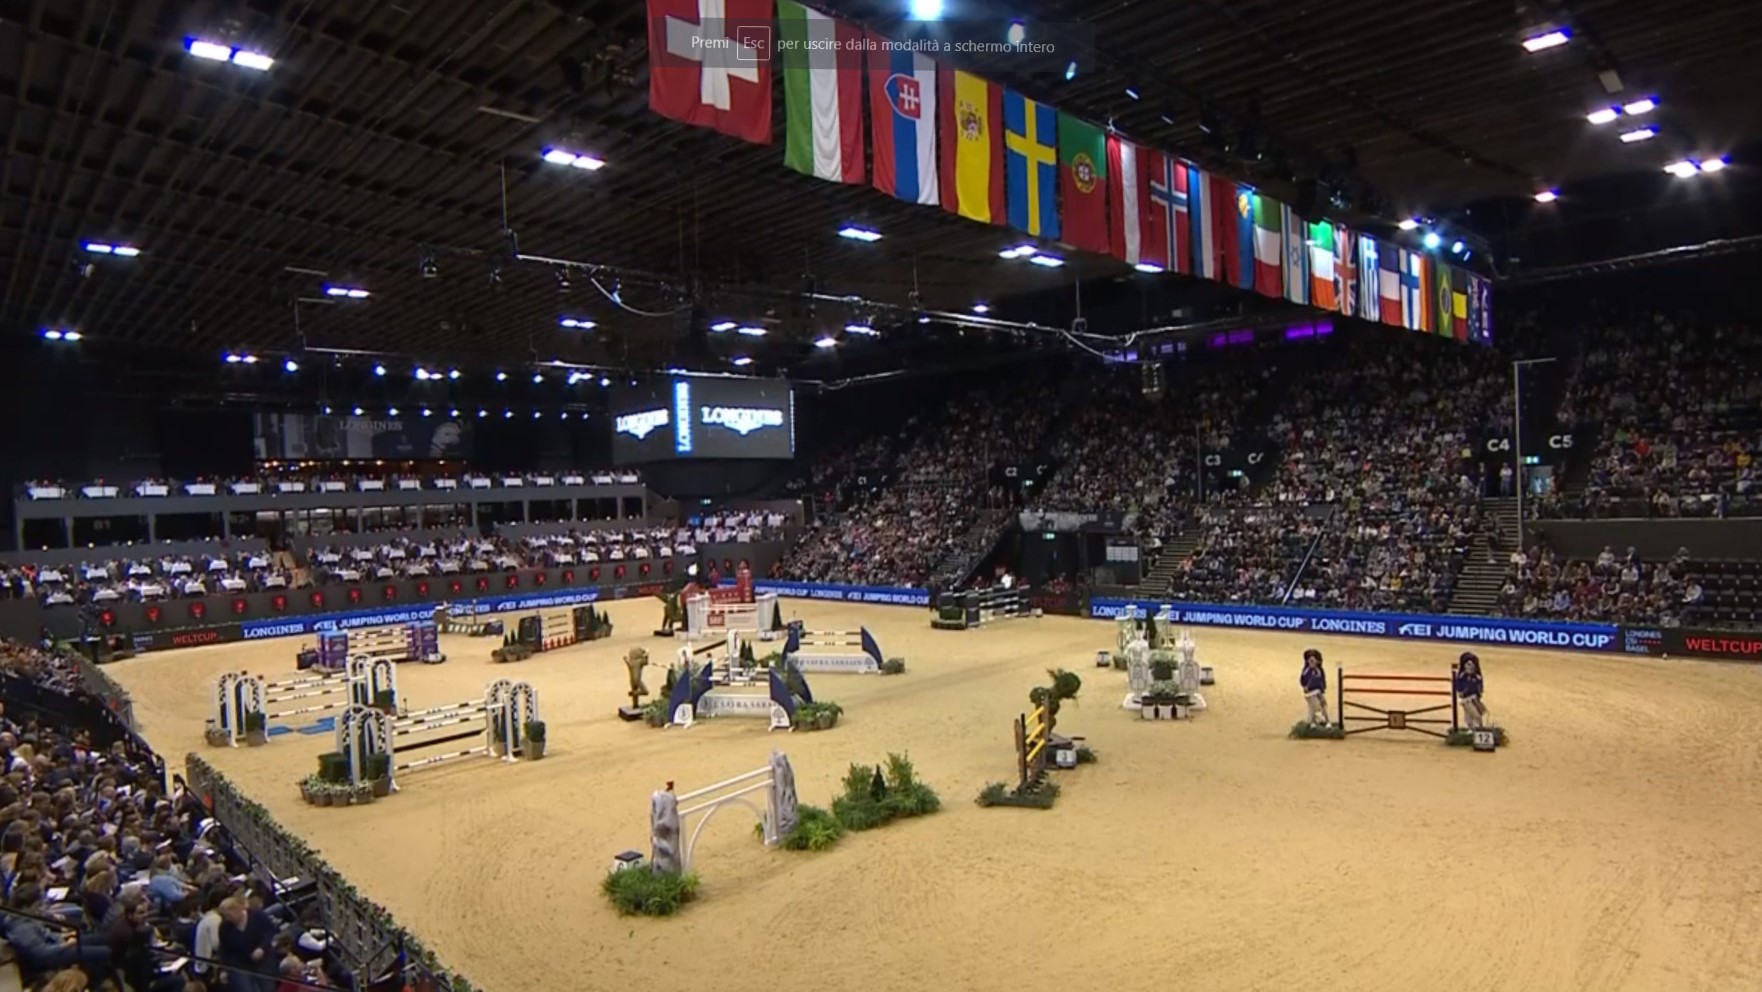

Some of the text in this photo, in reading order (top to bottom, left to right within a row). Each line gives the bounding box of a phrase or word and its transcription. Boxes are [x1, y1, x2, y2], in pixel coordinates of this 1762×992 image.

[701, 406, 783, 427] LONGINES
[339, 419, 405, 432] LONGINES
[1486, 439, 1511, 453] C4
[1548, 435, 1573, 449] C5
[1205, 454, 1222, 467] C3
[1005, 466, 1018, 477] C2
[519, 598, 556, 609] JUMPING
[556, 595, 582, 606] WORLD
[582, 593, 598, 603] CUP
[892, 594, 916, 604] WORLD
[339, 614, 383, 628] JUMPING
[383, 612, 417, 625] WORLD
[1183, 610, 1233, 625] JUMPING
[1234, 613, 1277, 627] WORLD
[1278, 615, 1305, 628] CUP
[243, 623, 305, 639] LONGINES
[1311, 618, 1386, 635] LONGINES
[172, 632, 218, 645] WELTCUP
[1436, 625, 1507, 642] JUMPING
[1509, 629, 1570, 646] WORLD
[1572, 633, 1610, 648] CUP
[1625, 629, 1663, 639] LONGINES
[1625, 645, 1650, 653] BASEL
[1685, 637, 1762, 654] WELTCUP
[1478, 732, 1490, 743] 12
